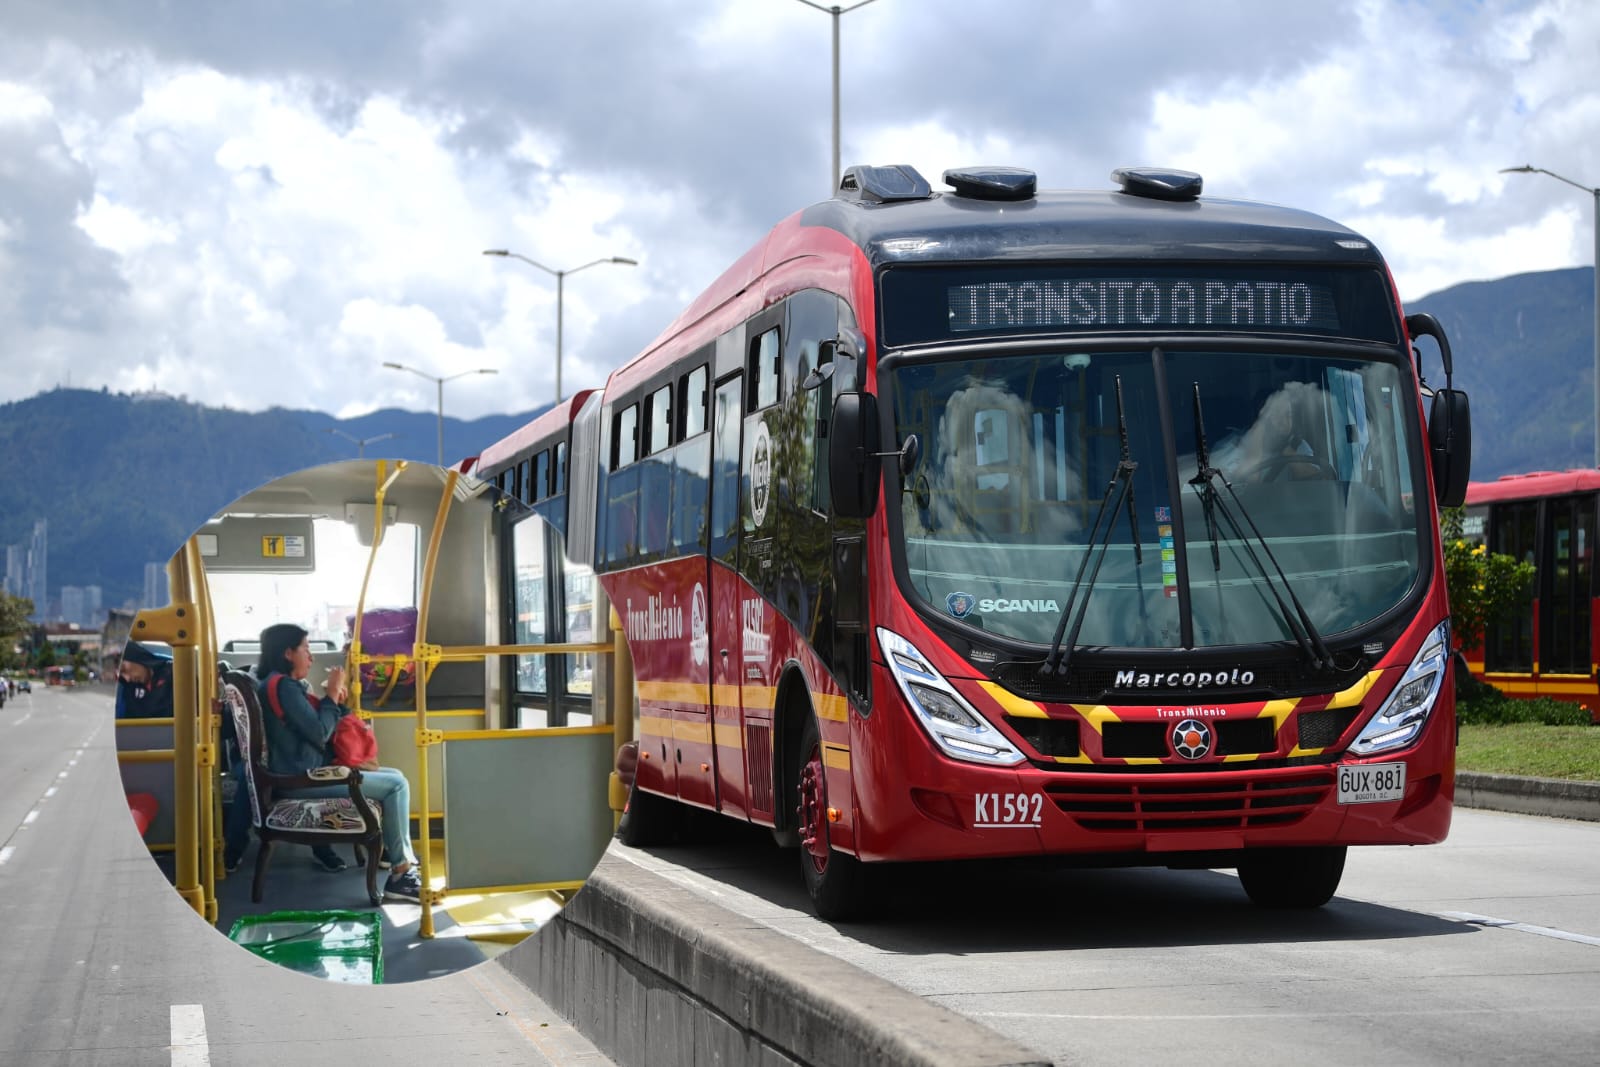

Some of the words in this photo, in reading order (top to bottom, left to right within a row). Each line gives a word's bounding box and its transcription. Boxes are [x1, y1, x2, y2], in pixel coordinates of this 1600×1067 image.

[961, 282, 1160, 324] TRANSITO
[1171, 282, 1196, 324] A
[1205, 282, 1312, 324] PATIO
[627, 592, 682, 640] TransMilenio
[979, 599, 1060, 612] SCANIA
[1114, 669, 1254, 688] Marcopolo
[1156, 707, 1226, 718] TransMilenio
[975, 793, 1043, 822] K1592
